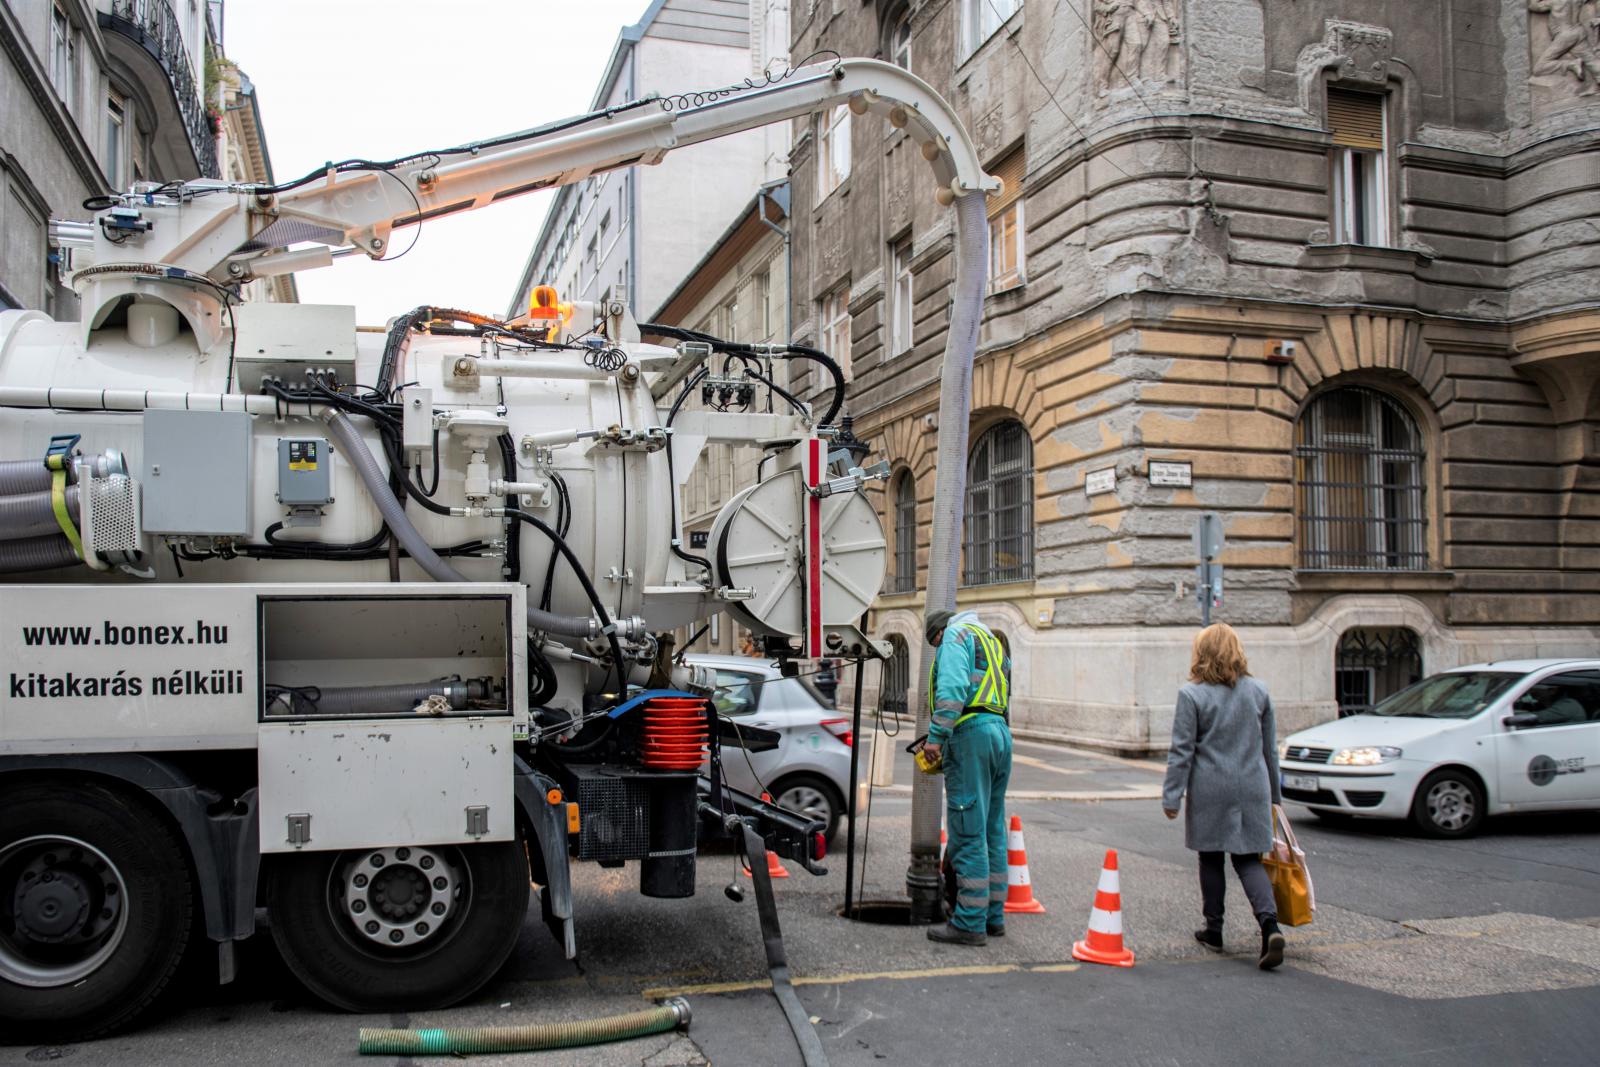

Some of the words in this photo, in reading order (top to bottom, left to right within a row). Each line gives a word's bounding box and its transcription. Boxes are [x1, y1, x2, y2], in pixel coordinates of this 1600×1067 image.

[23, 620, 228, 645] www.bonex.hu
[10, 670, 142, 697] kitakarás
[152, 669, 243, 695] nélküli
